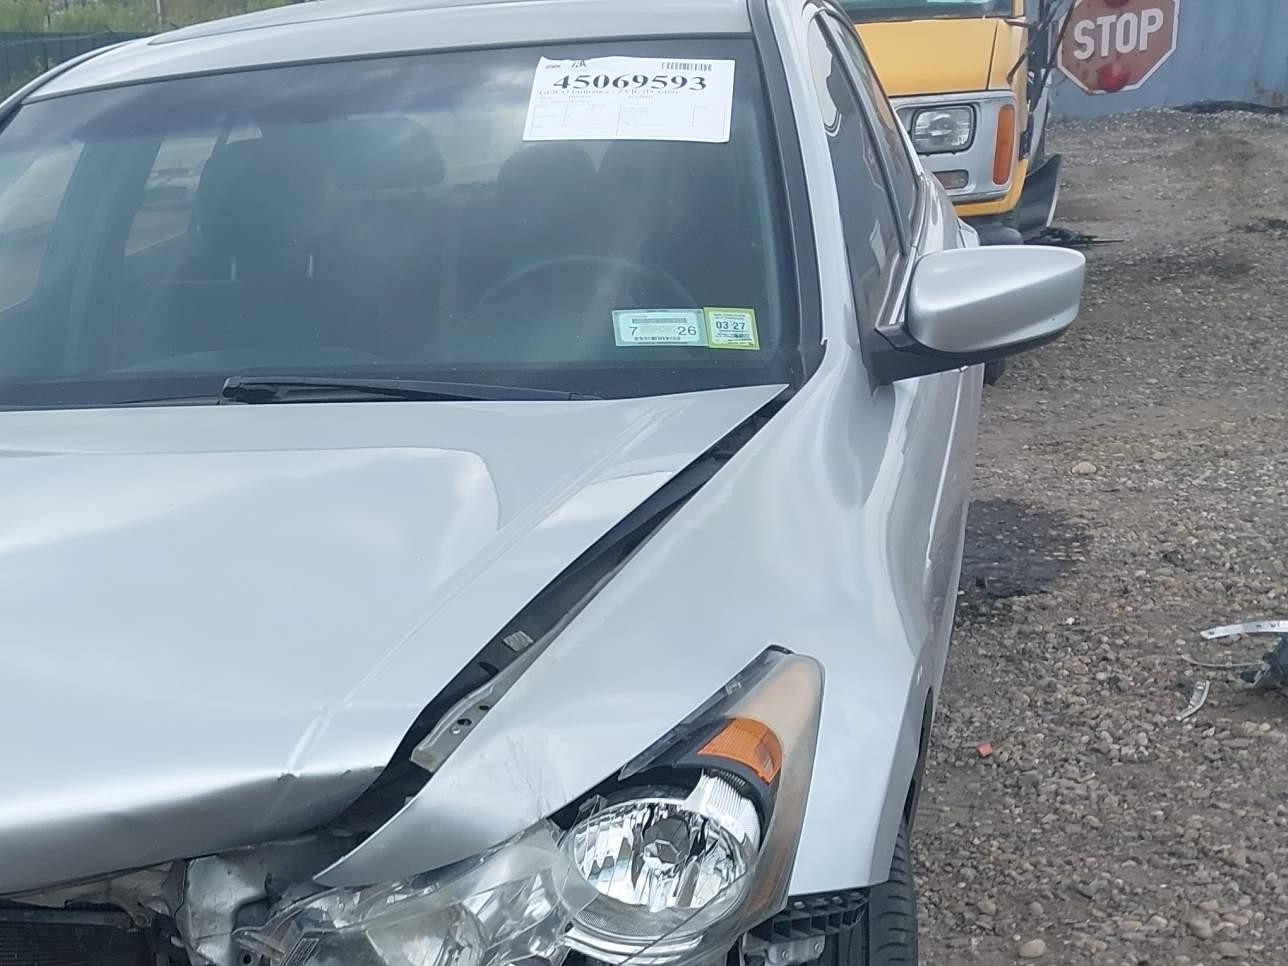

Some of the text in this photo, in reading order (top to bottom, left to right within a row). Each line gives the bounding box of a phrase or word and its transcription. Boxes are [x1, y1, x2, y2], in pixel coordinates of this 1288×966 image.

[1073, 8, 1164, 60] STOP
[553, 74, 707, 91] 45069593
[677, 325, 697, 336] 26
[716, 320, 745, 330] 03 27
